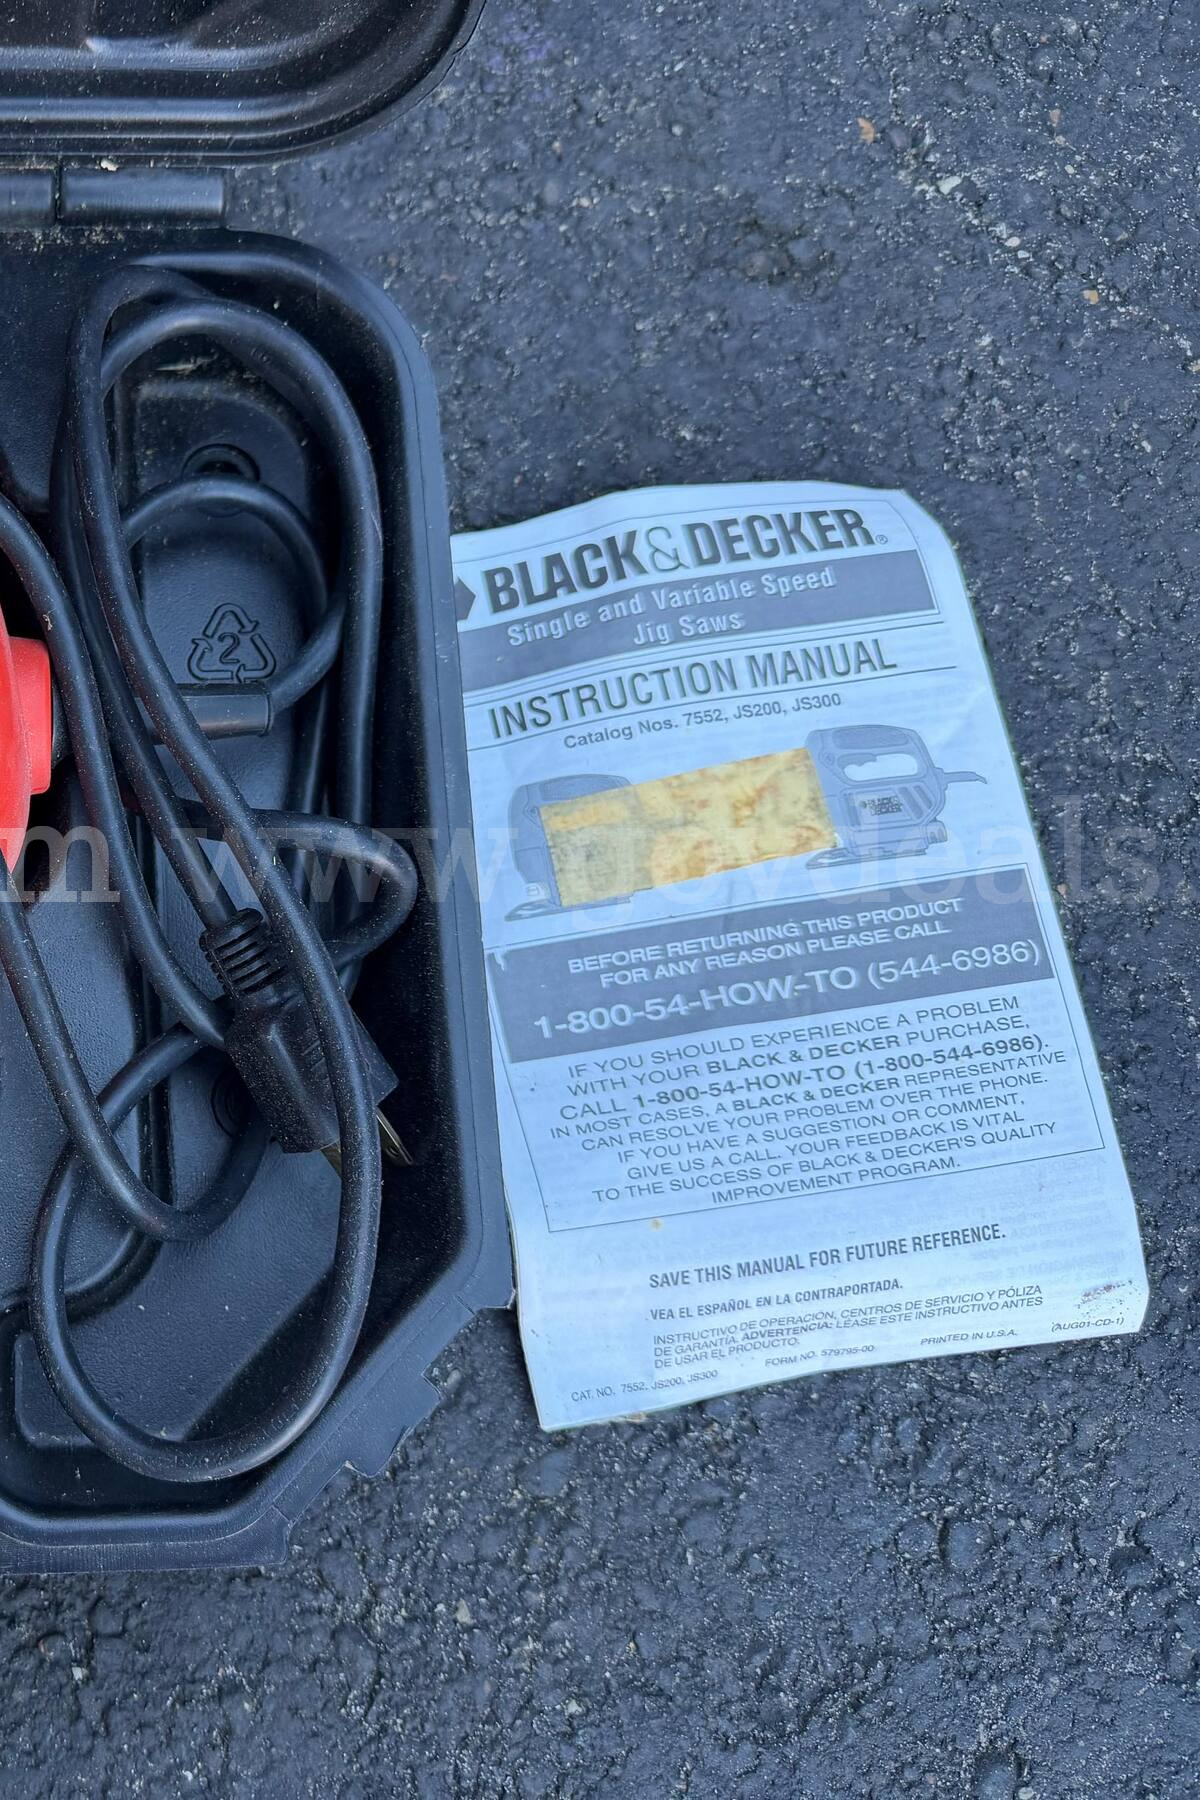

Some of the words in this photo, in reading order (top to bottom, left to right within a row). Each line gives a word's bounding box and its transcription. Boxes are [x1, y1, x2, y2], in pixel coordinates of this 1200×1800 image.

[507, 610, 591, 646] Single
[598, 593, 643, 622] and
[652, 579, 754, 610] Variable
[762, 566, 836, 598] Speed
[633, 622, 670, 645] Jig
[678, 611, 744, 637] Saws
[218, 632, 240, 664] 2
[489, 658, 738, 738] INSTRUCTION
[745, 639, 897, 688] MANUAL
[564, 726, 633, 748] Catalog
[638, 719, 678, 734] Nos.
[682, 709, 728, 726] 7552,
[733, 701, 786, 720] JS200,
[792, 693, 841, 711] JS300
[568, 946, 662, 974] BEFORE
[666, 922, 799, 958] RETURNING
[802, 914, 853, 934] THIS
[857, 898, 965, 926] PRODUCT
[599, 967, 649, 988] FOR
[654, 959, 700, 980] ANY
[705, 940, 808, 971] REASON
[808, 928, 892, 954] PLEASE
[894, 920, 952, 940] CALL
[868, 939, 1040, 990] (544-6986)
[567, 1077, 627, 1097] WITH
[632, 1064, 700, 1087] YOUR
[707, 1051, 785, 1074] BLACK
[789, 1050, 804, 1063] &
[809, 1035, 900, 1060] DECKER
[907, 1015, 1030, 1045] PURCHASE,
[568, 1062, 588, 1078] IF
[593, 1054, 644, 1072] YOU
[650, 1037, 745, 1065] SHOULD
[751, 1015, 891, 1049] EXPERIENCE
[896, 1013, 911, 1027] A
[916, 996, 1019, 1023] PROBLEM
[550, 1126, 570, 1139] IN
[576, 1115, 632, 1134] MOST
[638, 1105, 709, 1124] CASES,
[714, 1102, 728, 1115] A
[734, 1091, 799, 1111] BLACK
[803, 1090, 816, 1102] &
[820, 1077, 900, 1099] DECKER
[905, 1051, 1066, 1086] REPRESENTATIVE
[559, 1098, 627, 1120] CALL
[633, 1064, 846, 1108] 1-800-54-HOW-TO
[854, 1033, 1049, 1080] (1-800-544-6986).
[581, 1135, 623, 1151] CAN
[629, 1121, 719, 1145] RESOLVE
[724, 1111, 779, 1130] YOUR
[784, 1099, 875, 1121] PROBLEM
[880, 1089, 932, 1107] OVER
[937, 1083, 975, 1099] THE
[980, 1072, 1048, 1091] PHONE.
[618, 1150, 637, 1163] IF
[640, 1143, 681, 1160] YOU
[687, 1135, 738, 1153] HAVE
[745, 1132, 759, 1145] A
[764, 1113, 885, 1142] SUGGESTION
[892, 1107, 919, 1123] OR
[924, 1092, 1025, 1119] COMMENT,
[592, 1187, 620, 1201] TO
[625, 1182, 666, 1198] THE
[670, 1168, 762, 1191] SUCCESS
[767, 1162, 792, 1177] OF
[800, 1153, 861, 1173] BLACK
[865, 1150, 878, 1163] &
[882, 1135, 976, 1160] DECKER'S
[981, 1122, 1057, 1144] QUALITY
[627, 1163, 673, 1181] GIVE
[678, 1157, 704, 1172] US
[711, 1155, 723, 1168] A
[728, 1147, 781, 1165] CALL.
[785, 1137, 840, 1156] YOUR
[845, 1124, 947, 1147] FEEDBACK
[950, 1118, 968, 1132] IS
[974, 1110, 1025, 1128] VITAL
[712, 1172, 853, 1203] IMPROVEMENT
[859, 1156, 961, 1182] PROGRAM.
[649, 1270, 691, 1288] SAVE
[694, 1264, 732, 1283] THIS
[737, 1254, 804, 1279] MANUAL
[809, 1248, 841, 1268] FOR
[845, 1238, 908, 1263] FUTURE
[912, 1223, 1006, 1252] REFERENCE.
[650, 1308, 675, 1320] VEA
[679, 1306, 693, 1318] EL
[697, 1298, 752, 1317] ESPAÑOL
[756, 1296, 772, 1308] EN
[776, 1294, 791, 1305] LA
[795, 1278, 903, 1303] CONTRAPORTADA.
[654, 1324, 738, 1345] INSTRUCTIVO
[740, 1320, 757, 1332] DE
[840, 1302, 902, 1319] CENTROS
[905, 1300, 923, 1311] DE
[925, 1292, 984, 1308] SERVICIO
[987, 1290, 996, 1300] Y
[998, 1285, 1042, 1299] PÓLIZA
[654, 1346, 672, 1357] DE
[742, 1321, 833, 1340] ADVERTENCIA:
[879, 1312, 913, 1325] ESTE
[915, 1301, 999, 1320] INSTRUCTIVO
[1001, 1296, 1043, 1308] ANTES
[654, 1358, 672, 1369] DE
[675, 1352, 708, 1366] USAR
[711, 1349, 727, 1359] EL
[728, 1337, 800, 1356] PRODUCTO.
[765, 1355, 798, 1367] FORM
[799, 1350, 818, 1362] NO.
[920, 1333, 968, 1345] PRINTED
[971, 1331, 984, 1341] IN
[986, 1329, 1018, 1340] U.S.A.
[571, 1390, 594, 1402] CAT.
[596, 1386, 615, 1398] NO.
[687, 1369, 718, 1383] JS300
